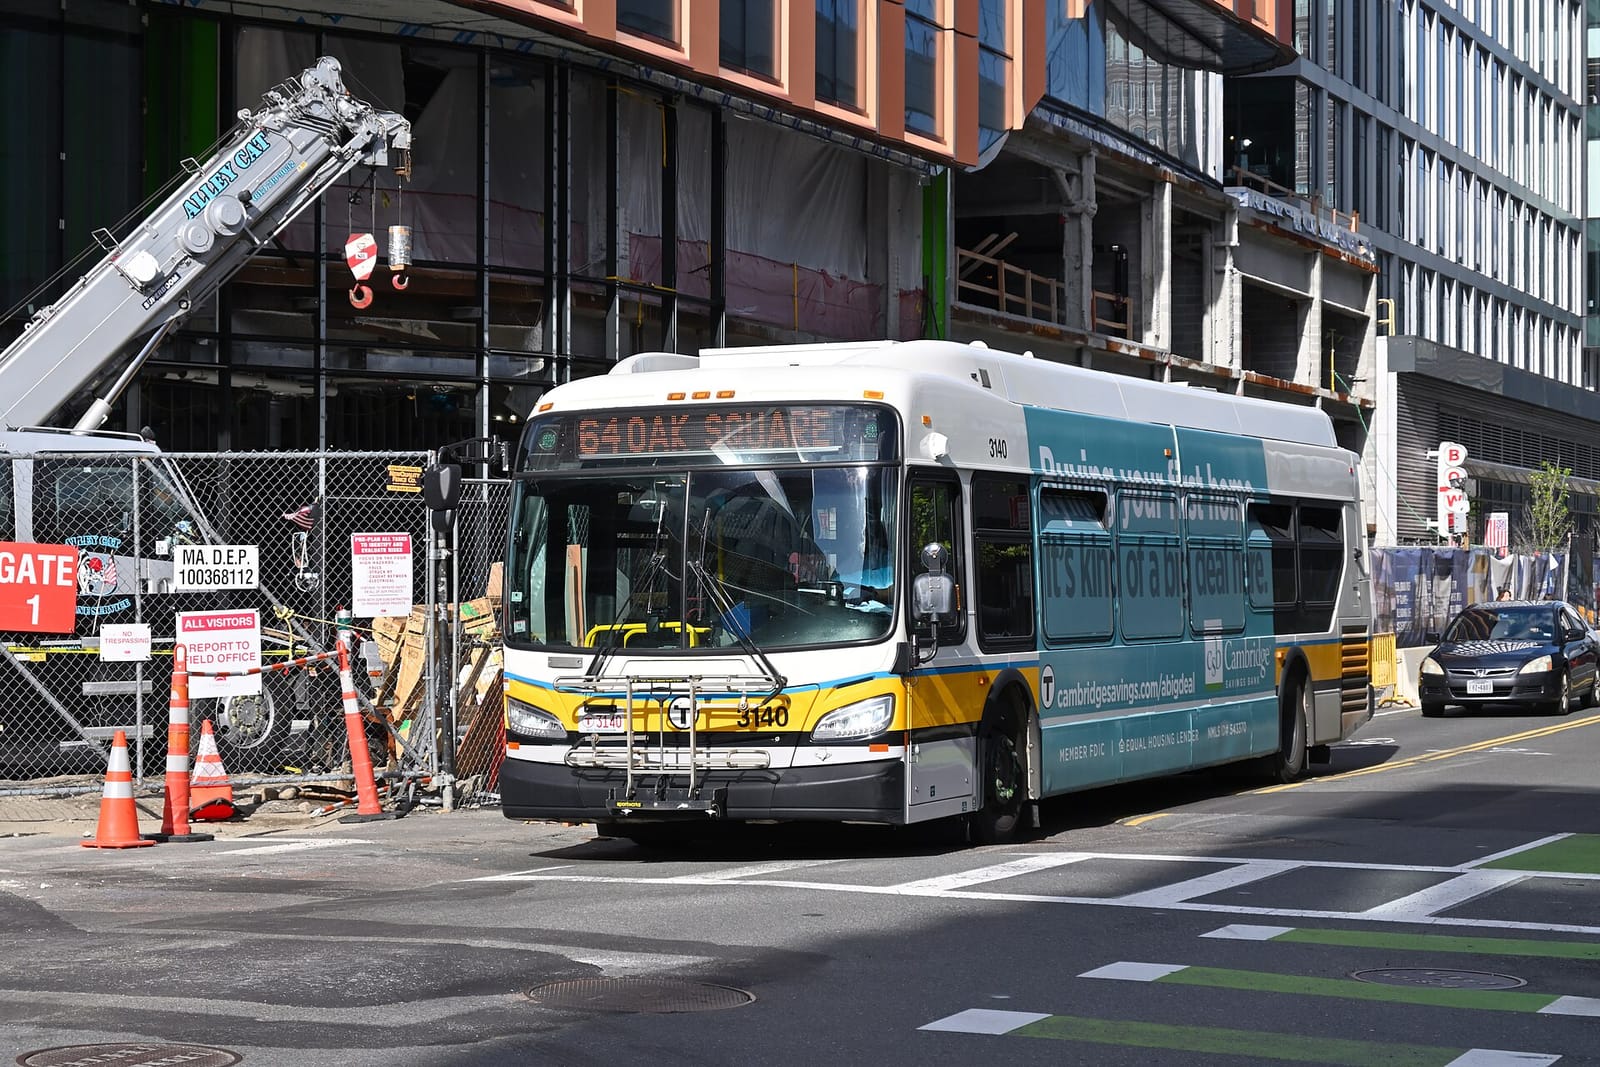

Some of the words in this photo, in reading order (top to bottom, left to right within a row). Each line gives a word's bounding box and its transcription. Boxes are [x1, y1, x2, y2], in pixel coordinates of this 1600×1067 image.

[182, 161, 238, 220] ALLEY
[234, 131, 271, 170] CAT
[579, 417, 620, 454] 64
[627, 413, 689, 453] OAK
[704, 409, 831, 447] SQUARE
[988, 438, 1008, 459] 3140
[1120, 467, 1163, 529] your
[182, 549, 208, 565] MA.
[213, 549, 250, 565] D.E.P.
[1046, 533, 1076, 598] It's
[1126, 537, 1145, 598] of
[1149, 550, 1160, 598] a
[1196, 538, 1230, 596] deal
[0, 552, 74, 586] GATE
[179, 568, 254, 585] 100368112
[26, 594, 40, 625] 1
[184, 619, 205, 629] ALL
[206, 616, 253, 628] VISITORS
[105, 637, 150, 645] TRESPASSING
[189, 641, 235, 653] REPORT
[236, 640, 250, 651] TO
[217, 652, 256, 664] OFFICE
[1224, 639, 1271, 679] Cambridge
[1057, 672, 1196, 708] cambridgesavings.com/abigdeal
[596, 715, 622, 728] 3140
[736, 706, 789, 728] 3140
[1126, 738, 1147, 752] EQUAL
[1148, 732, 1175, 749] HOUSING
[1176, 729, 1200, 743] LENDER
[1059, 745, 1088, 762] MEMBER
[1089, 743, 1105, 758] FDIC
